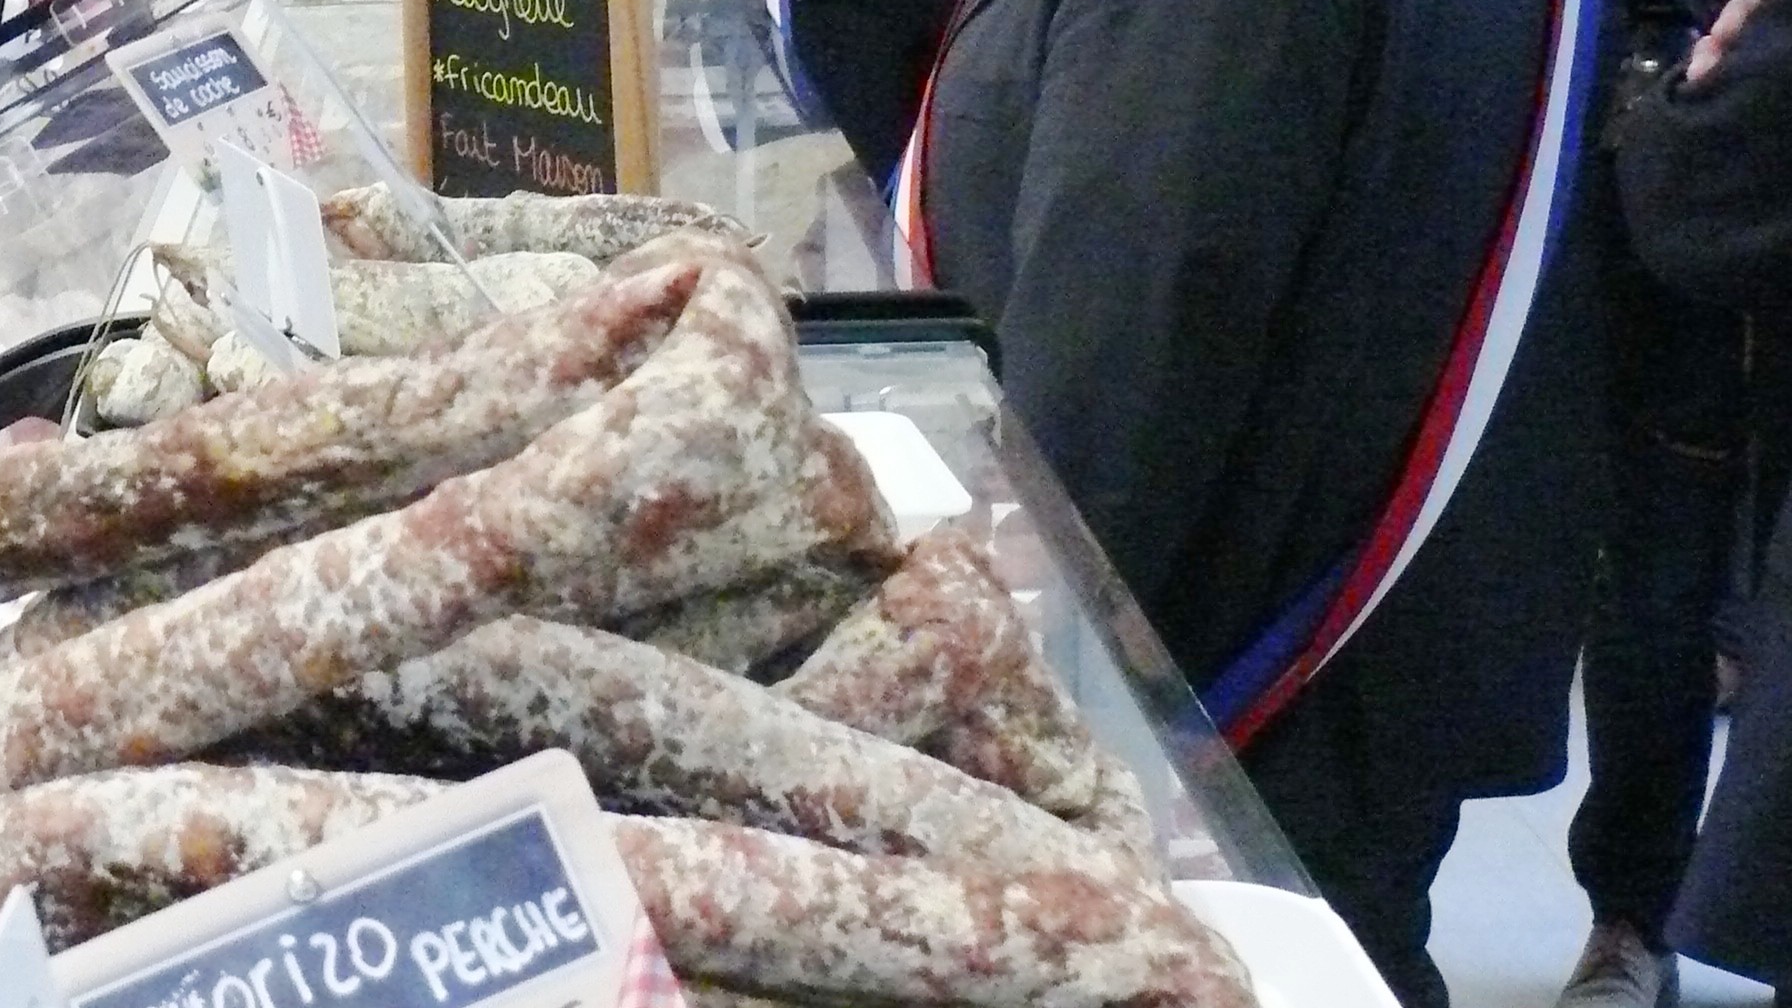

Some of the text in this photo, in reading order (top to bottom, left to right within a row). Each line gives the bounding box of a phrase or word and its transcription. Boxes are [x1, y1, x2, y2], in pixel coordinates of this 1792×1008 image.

[149, 47, 238, 90] Saucisson
[161, 75, 241, 119] de coche
[440, 111, 604, 194] Fait Maison
[410, 885, 588, 1003] PERCHE
